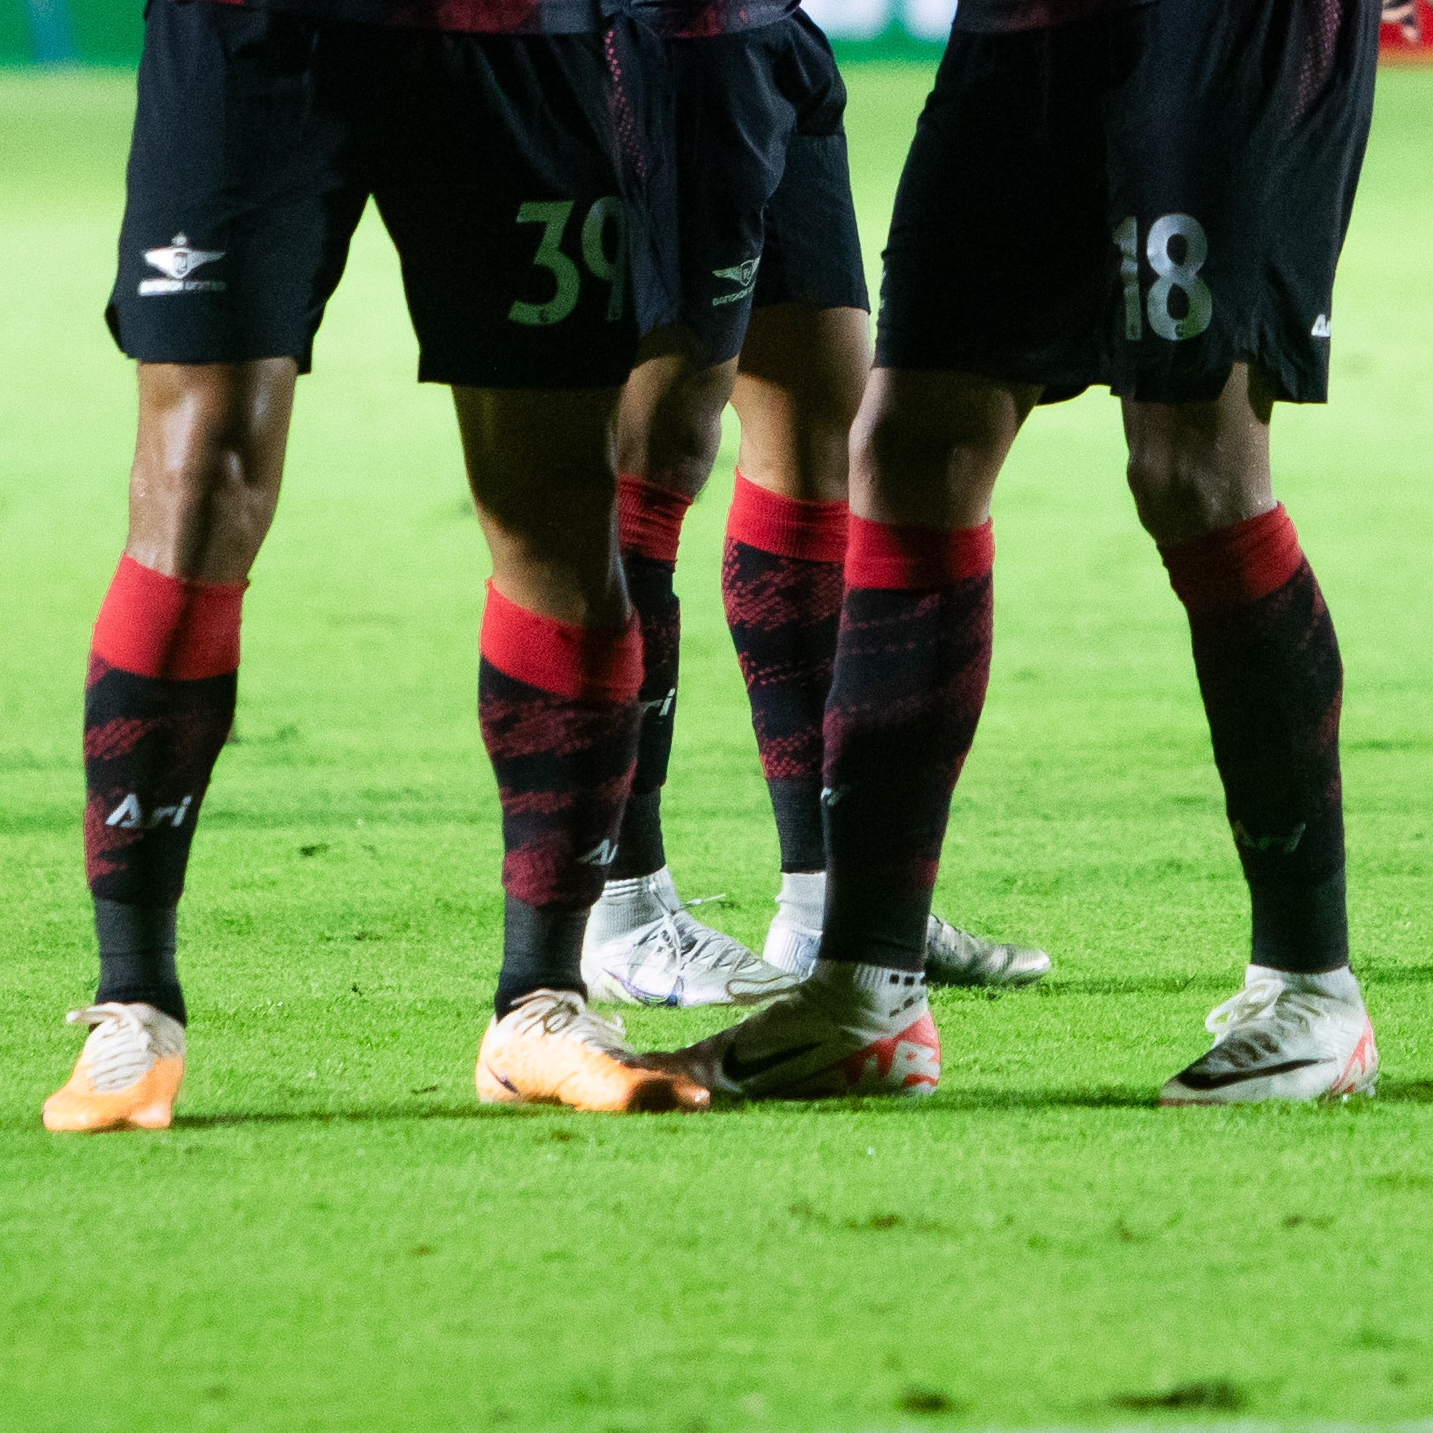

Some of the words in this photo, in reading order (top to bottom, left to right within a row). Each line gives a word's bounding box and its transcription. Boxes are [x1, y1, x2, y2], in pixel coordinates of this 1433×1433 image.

[507, 194, 625, 326] 39
[1112, 212, 1213, 342] 18
[105, 793, 192, 828] Ari
